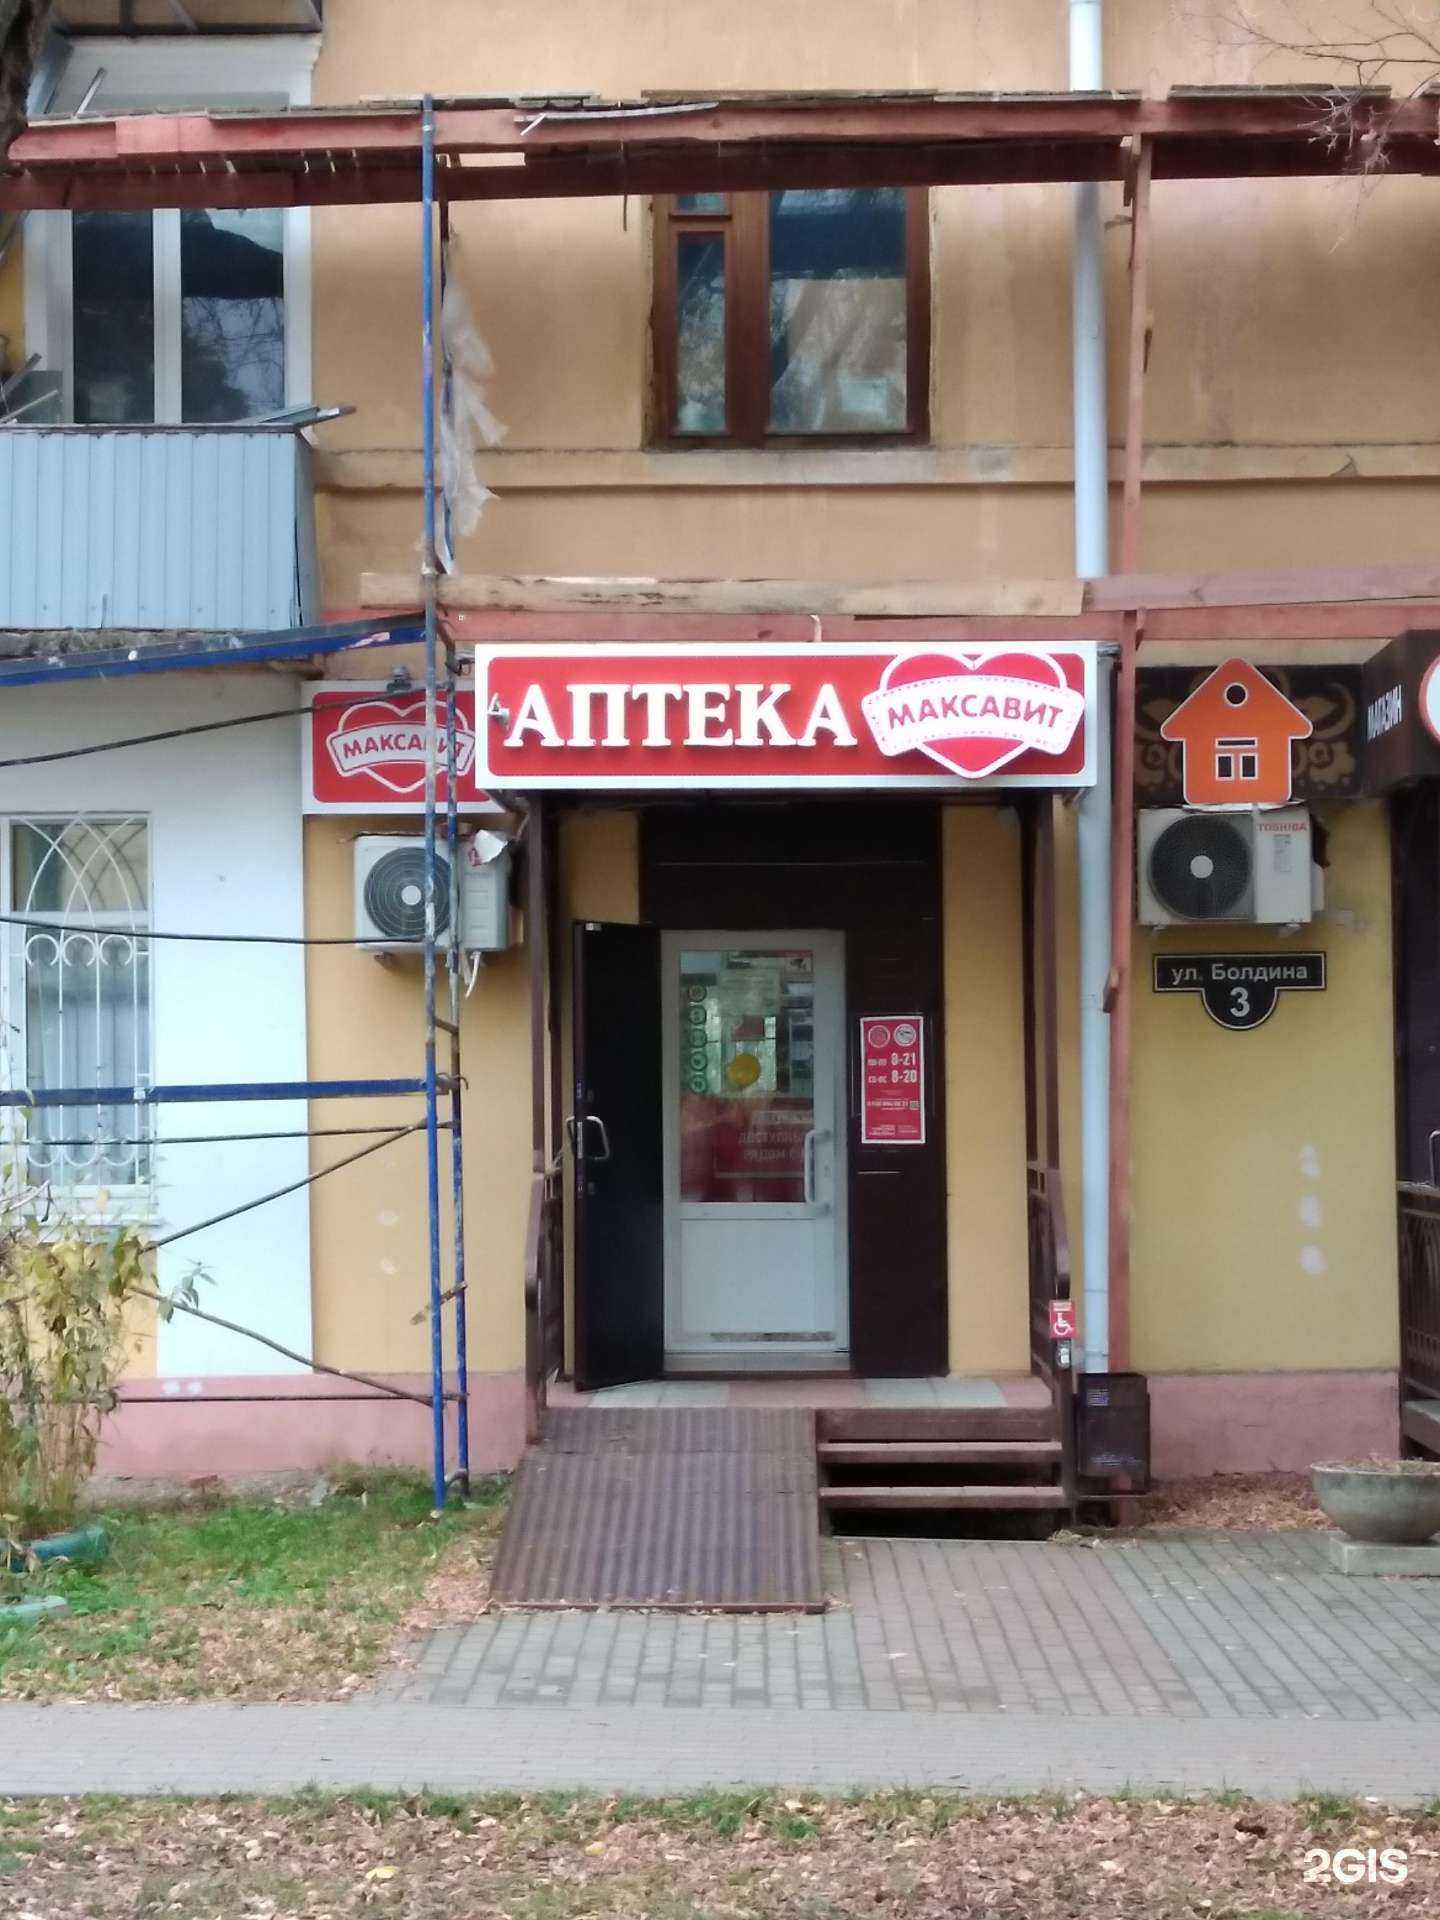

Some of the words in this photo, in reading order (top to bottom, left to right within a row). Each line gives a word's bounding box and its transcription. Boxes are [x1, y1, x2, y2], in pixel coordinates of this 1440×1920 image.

[503, 683, 858, 748] АПТЕКА
[887, 694, 1064, 730] МАКСАВИТ
[1258, 823, 1307, 832] TOSHIBA
[1172, 967, 1204, 985] ул.
[1211, 963, 1308, 982] Болдина
[1230, 986, 1251, 1017] 3
